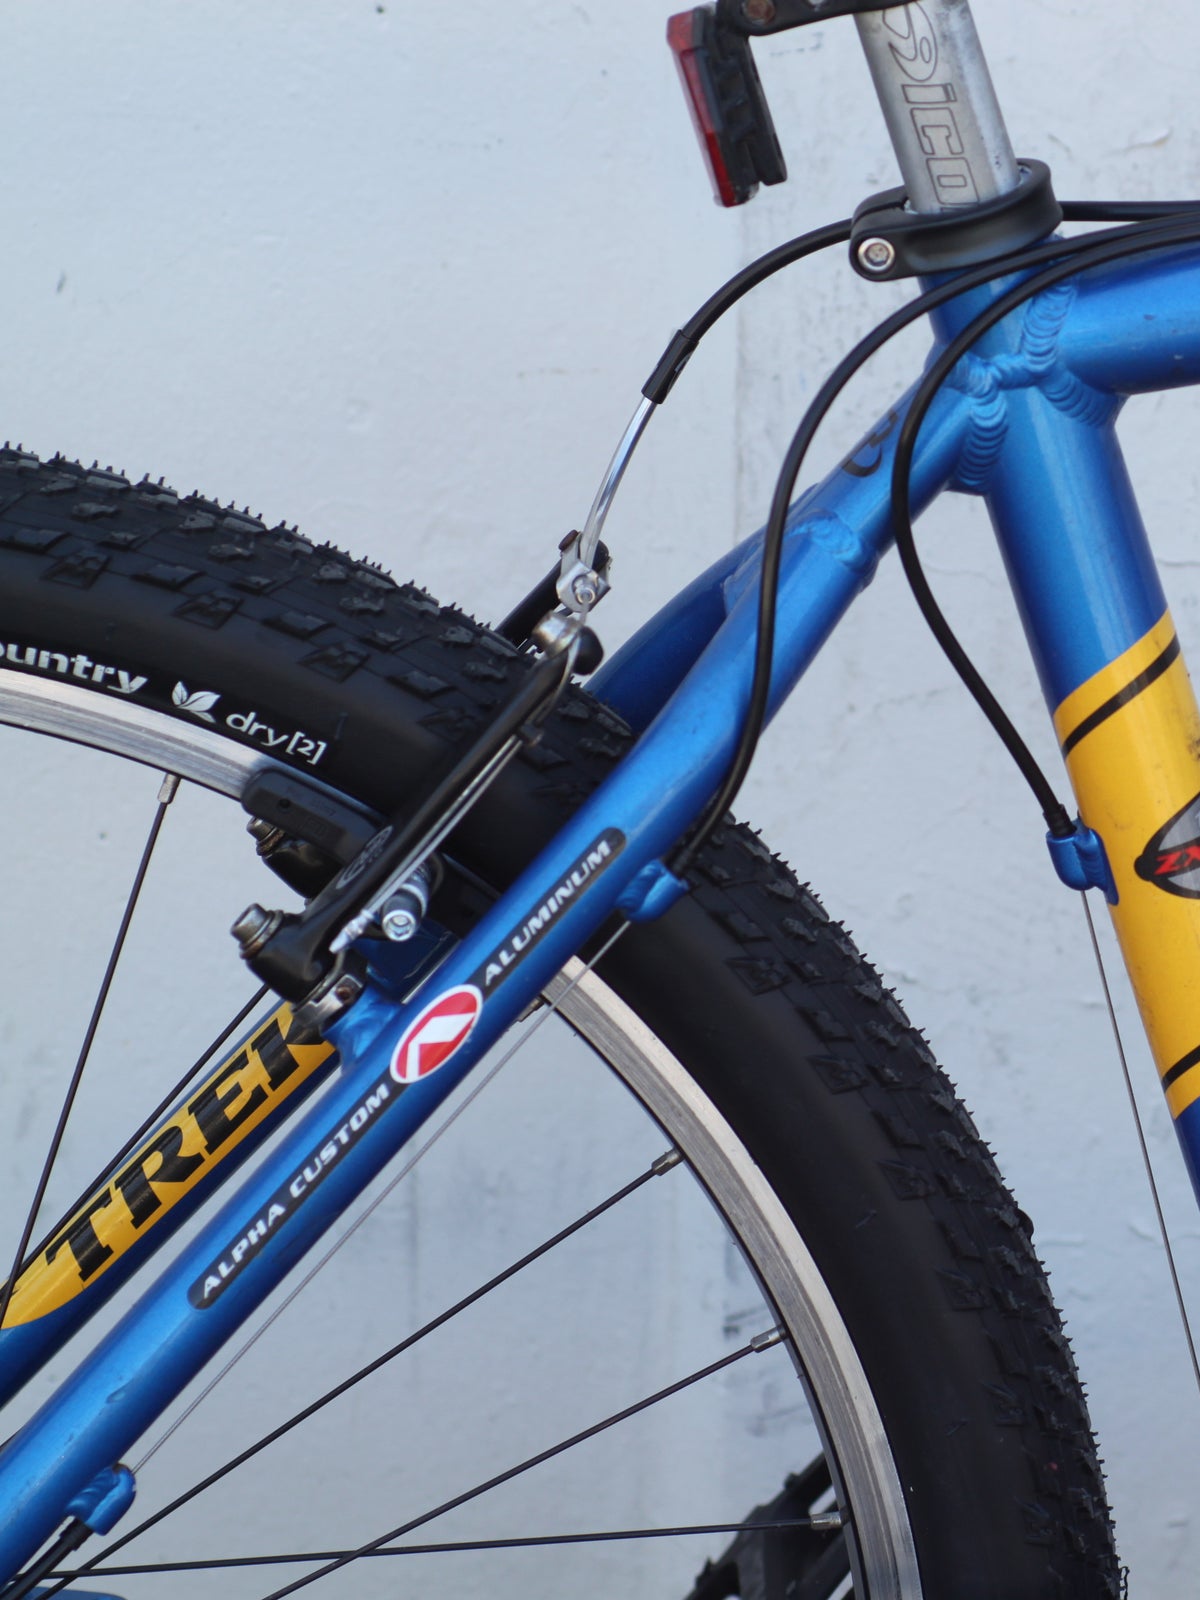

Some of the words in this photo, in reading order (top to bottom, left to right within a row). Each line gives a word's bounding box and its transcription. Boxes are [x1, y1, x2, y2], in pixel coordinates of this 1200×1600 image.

[0, 641, 148, 694] untry
[226, 711, 327, 765] dry[2]
[484, 838, 613, 986] ALUMINUM
[203, 1203, 286, 1299] ALPHA
[289, 1082, 391, 1199] CUSTOM
